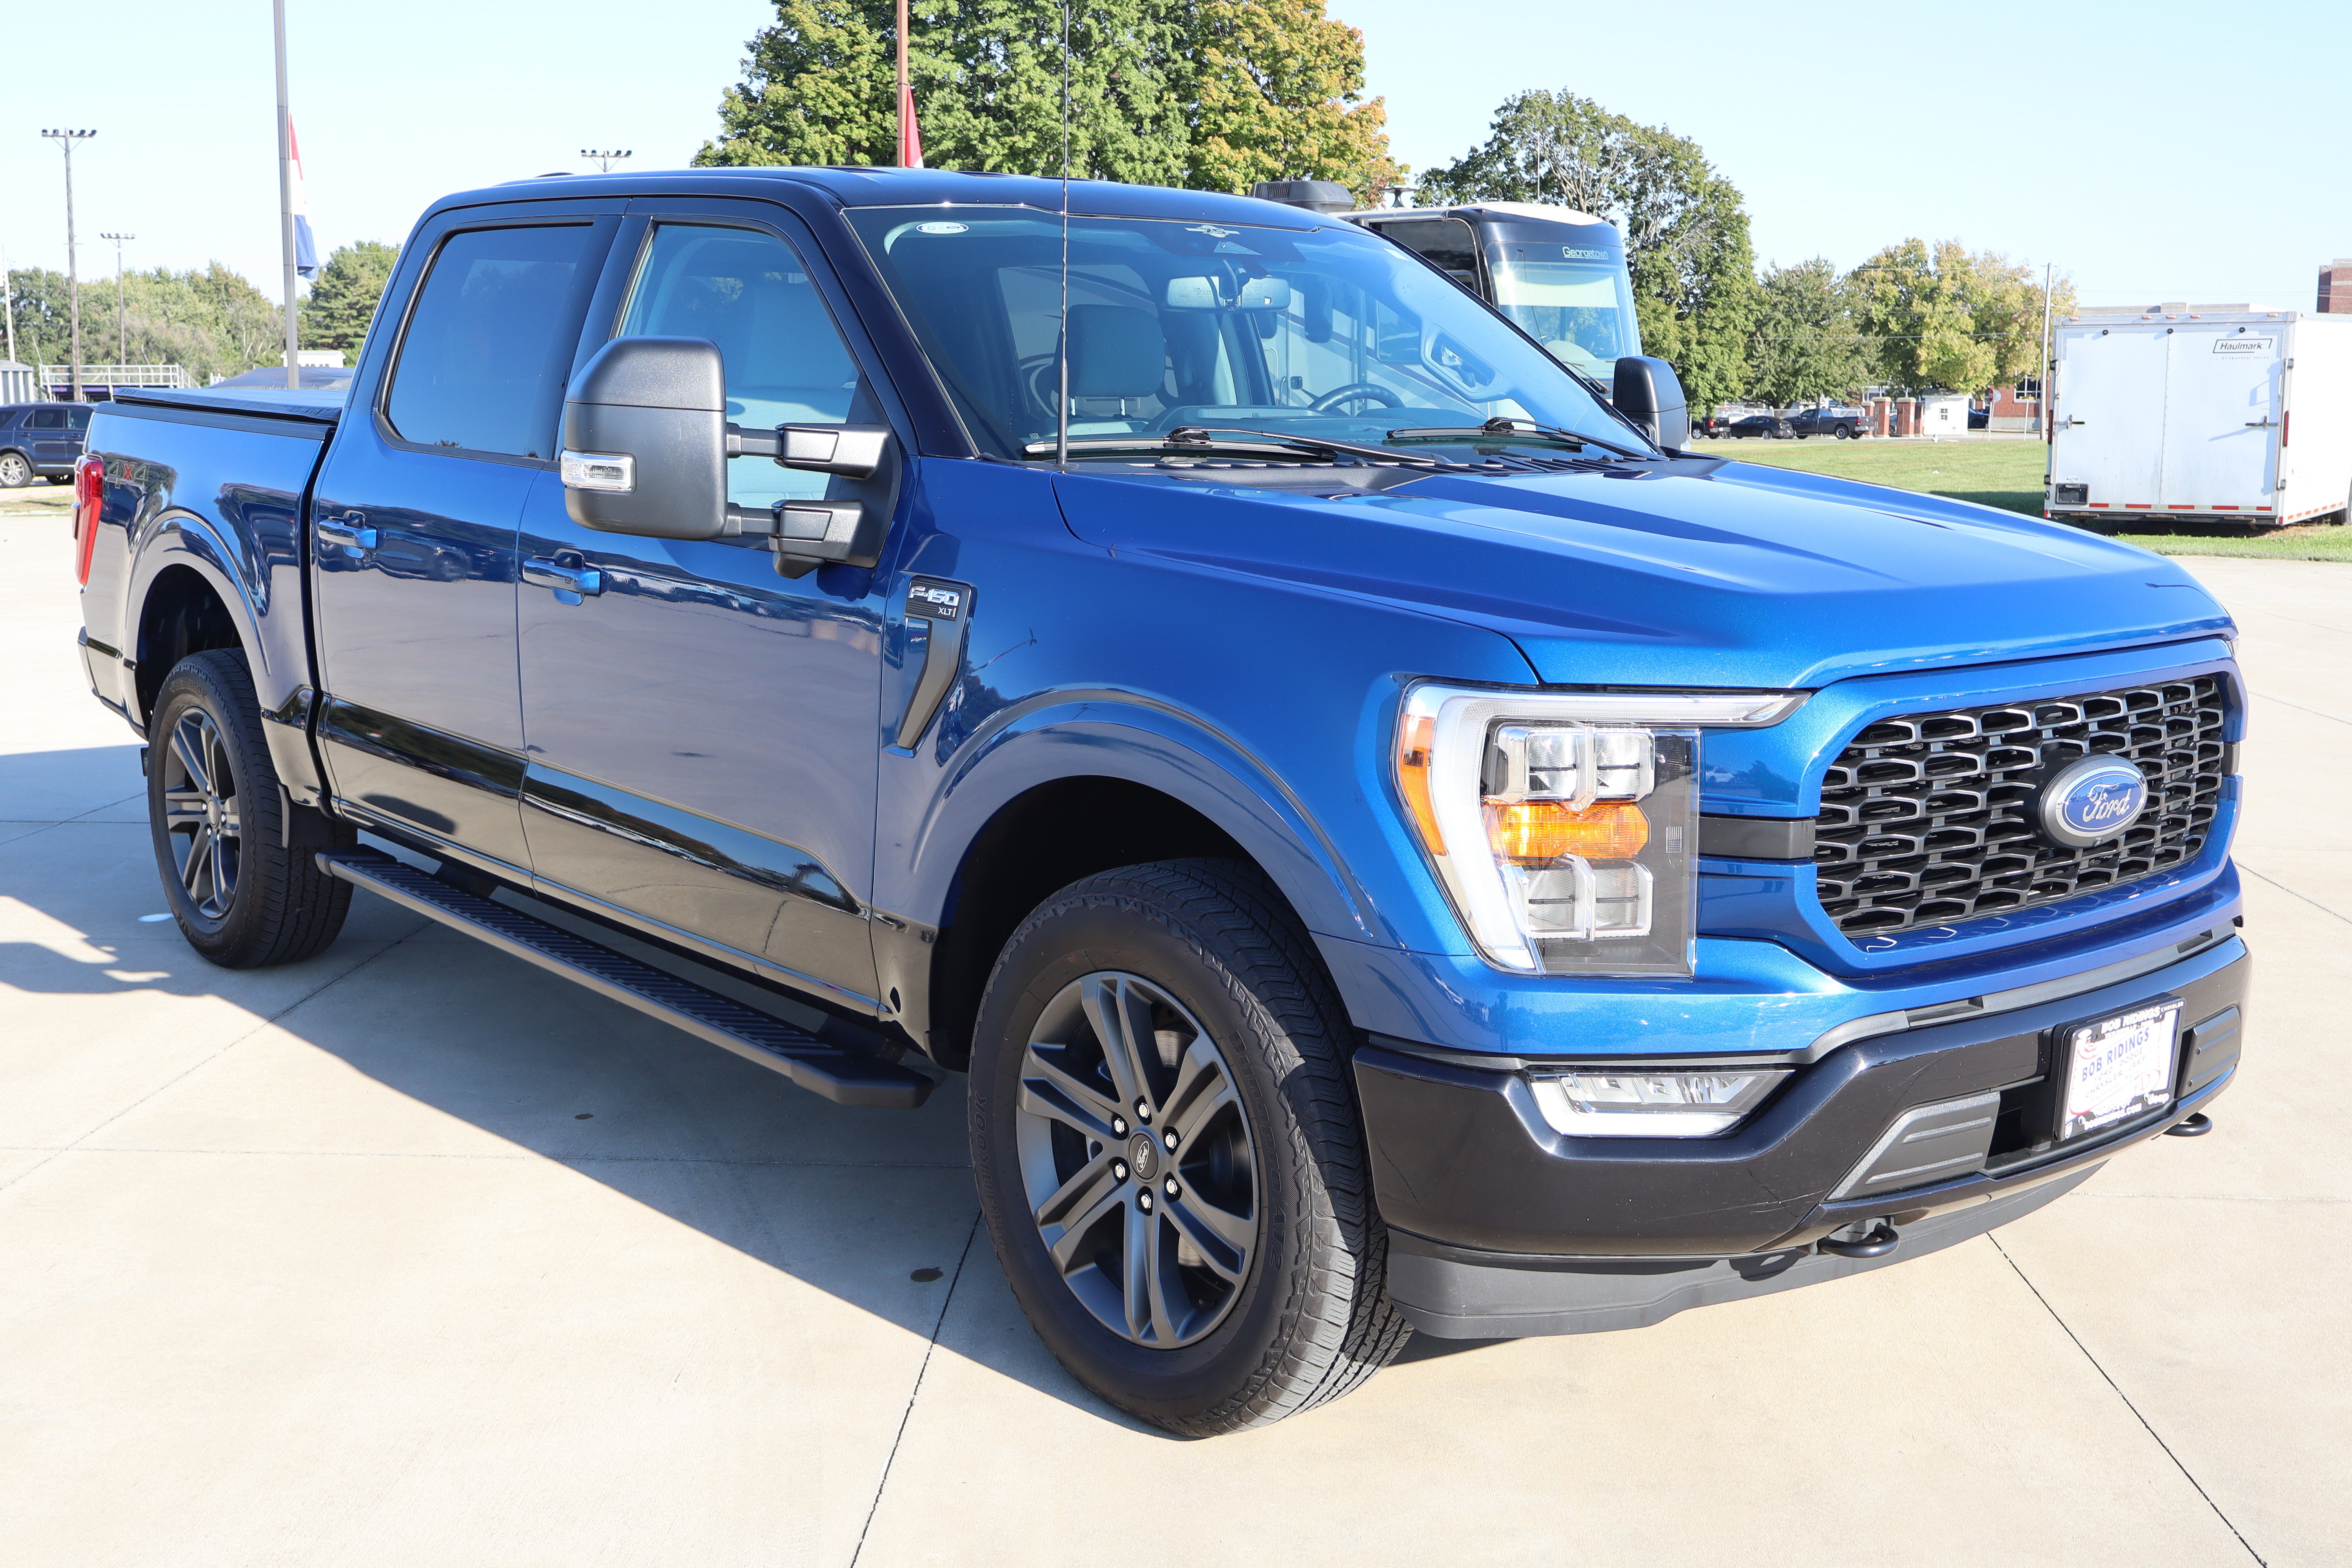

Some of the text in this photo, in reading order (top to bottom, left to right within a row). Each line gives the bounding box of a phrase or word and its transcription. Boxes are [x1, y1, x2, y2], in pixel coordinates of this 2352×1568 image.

[1562, 246, 1608, 260] Georgetown
[2220, 342, 2263, 350] Haulmark
[107, 459, 150, 493] 4X4
[909, 586, 960, 606] F-150
[938, 607, 953, 616] XLT
[2082, 782, 2132, 822] Ford
[2160, 1001, 2184, 1012] CHRYSLER
[2101, 1018, 2121, 1033] BOB
[2123, 1006, 2160, 1027] RIDINGS
[2082, 1057, 2102, 1082] BOB
[2107, 1027, 2149, 1065] RIDINGS
[2095, 1047, 2143, 1083] FORD DODGE
[2086, 1055, 2146, 1098] CHRYSLER JEEP
[2148, 1093, 2169, 1105] Jeep
[1138, 1145, 1148, 1168] Ford
[1228, 1031, 1287, 1272] Dynapro AT2
